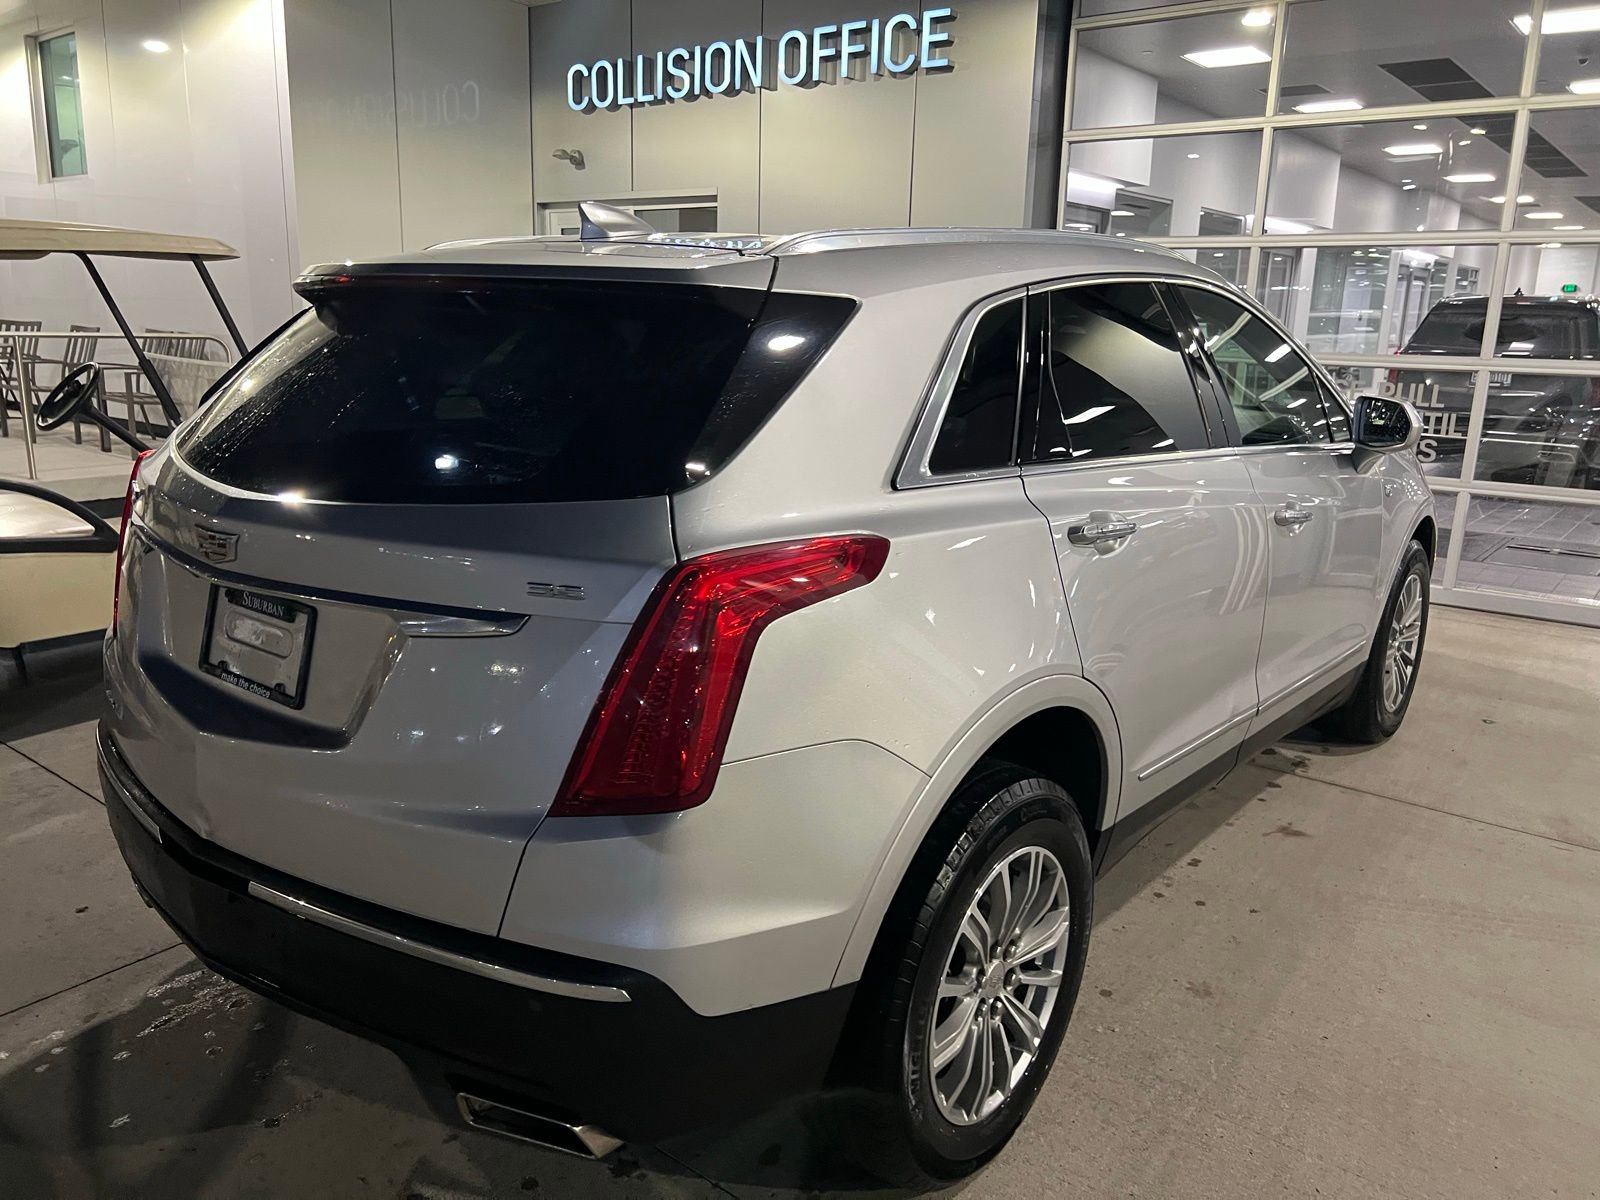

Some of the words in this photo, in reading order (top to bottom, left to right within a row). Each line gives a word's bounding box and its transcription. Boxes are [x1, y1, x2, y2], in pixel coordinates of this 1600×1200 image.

[566, 35, 763, 111] COLLISION
[778, 7, 953, 85] OFFICE
[220, 672, 238, 685] make
[238, 678, 249, 690] the
[249, 683, 271, 698] choice
